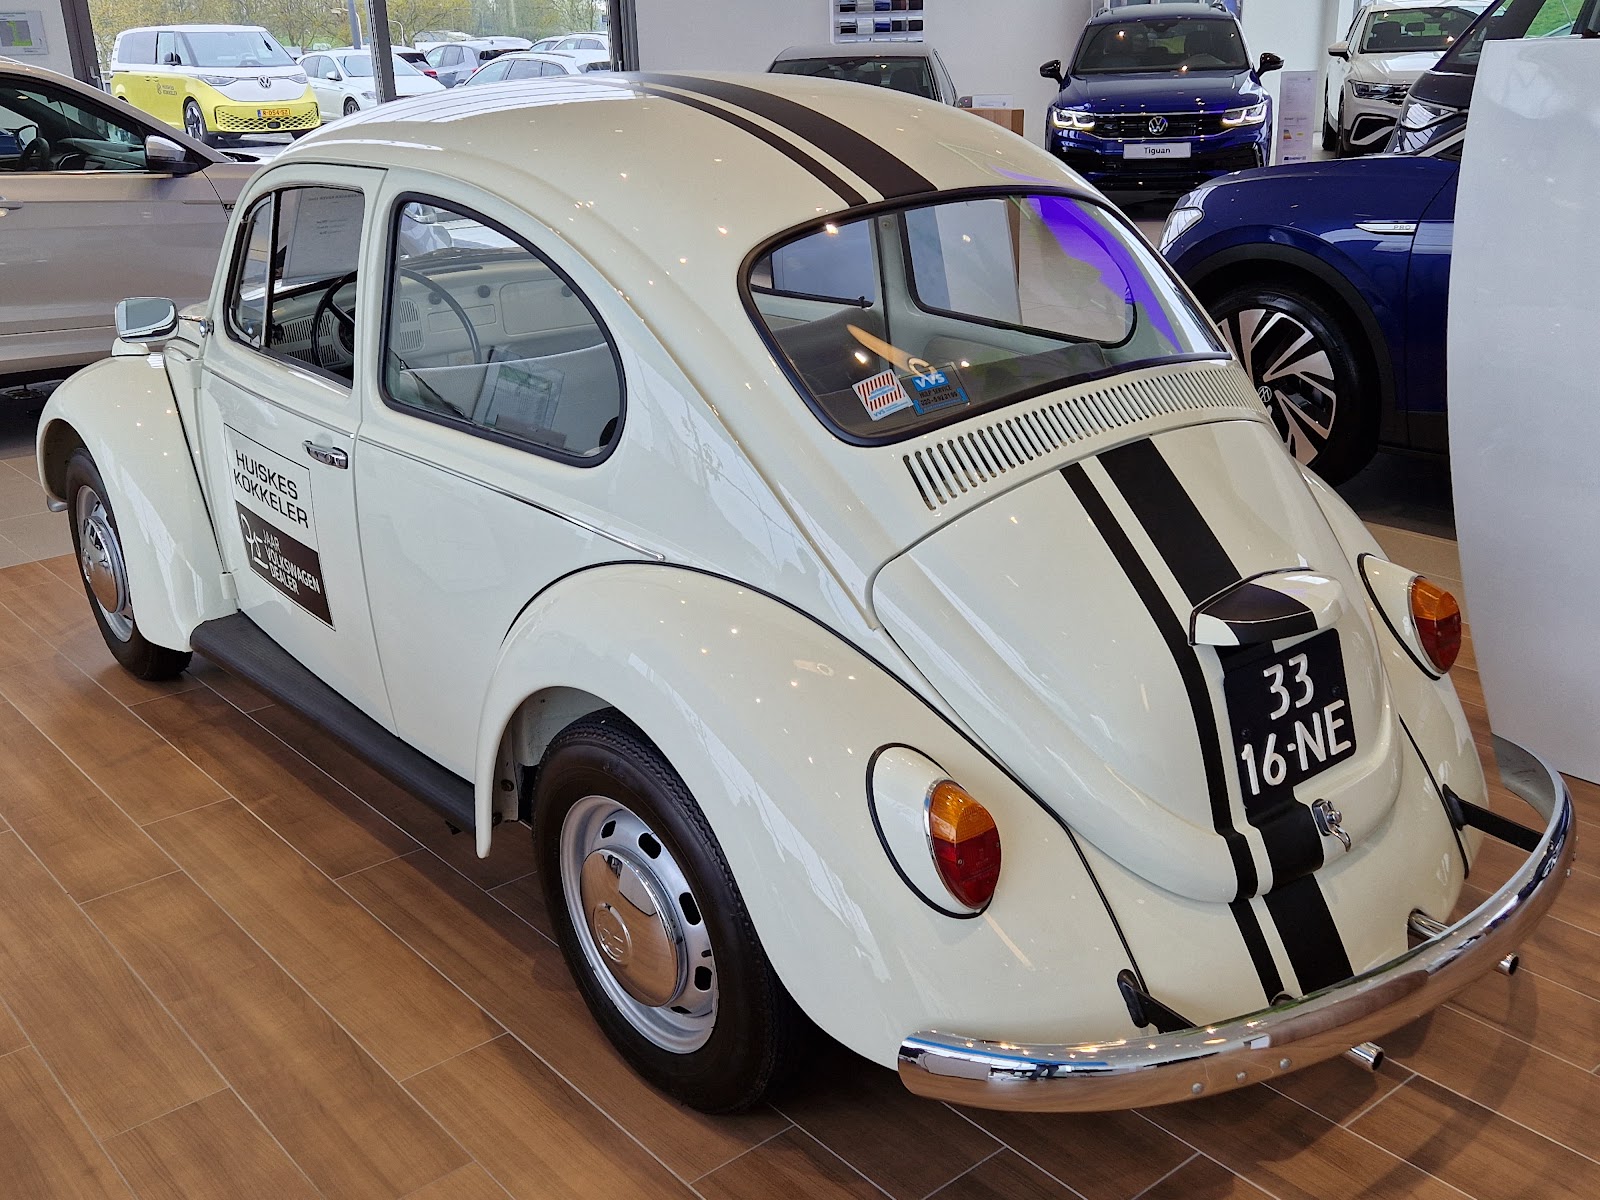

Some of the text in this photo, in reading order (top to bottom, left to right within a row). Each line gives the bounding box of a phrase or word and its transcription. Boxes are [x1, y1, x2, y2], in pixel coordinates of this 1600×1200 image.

[1144, 147, 1171, 156] Tiguan
[915, 373, 945, 388] VVS
[235, 449, 298, 500] HUISKES
[233, 469, 309, 529] KOKKELER
[262, 528, 281, 553] JAAR
[264, 545, 321, 594] VOLKSWAGEN
[269, 563, 300, 596] DEALER
[1262, 653, 1315, 721] 33
